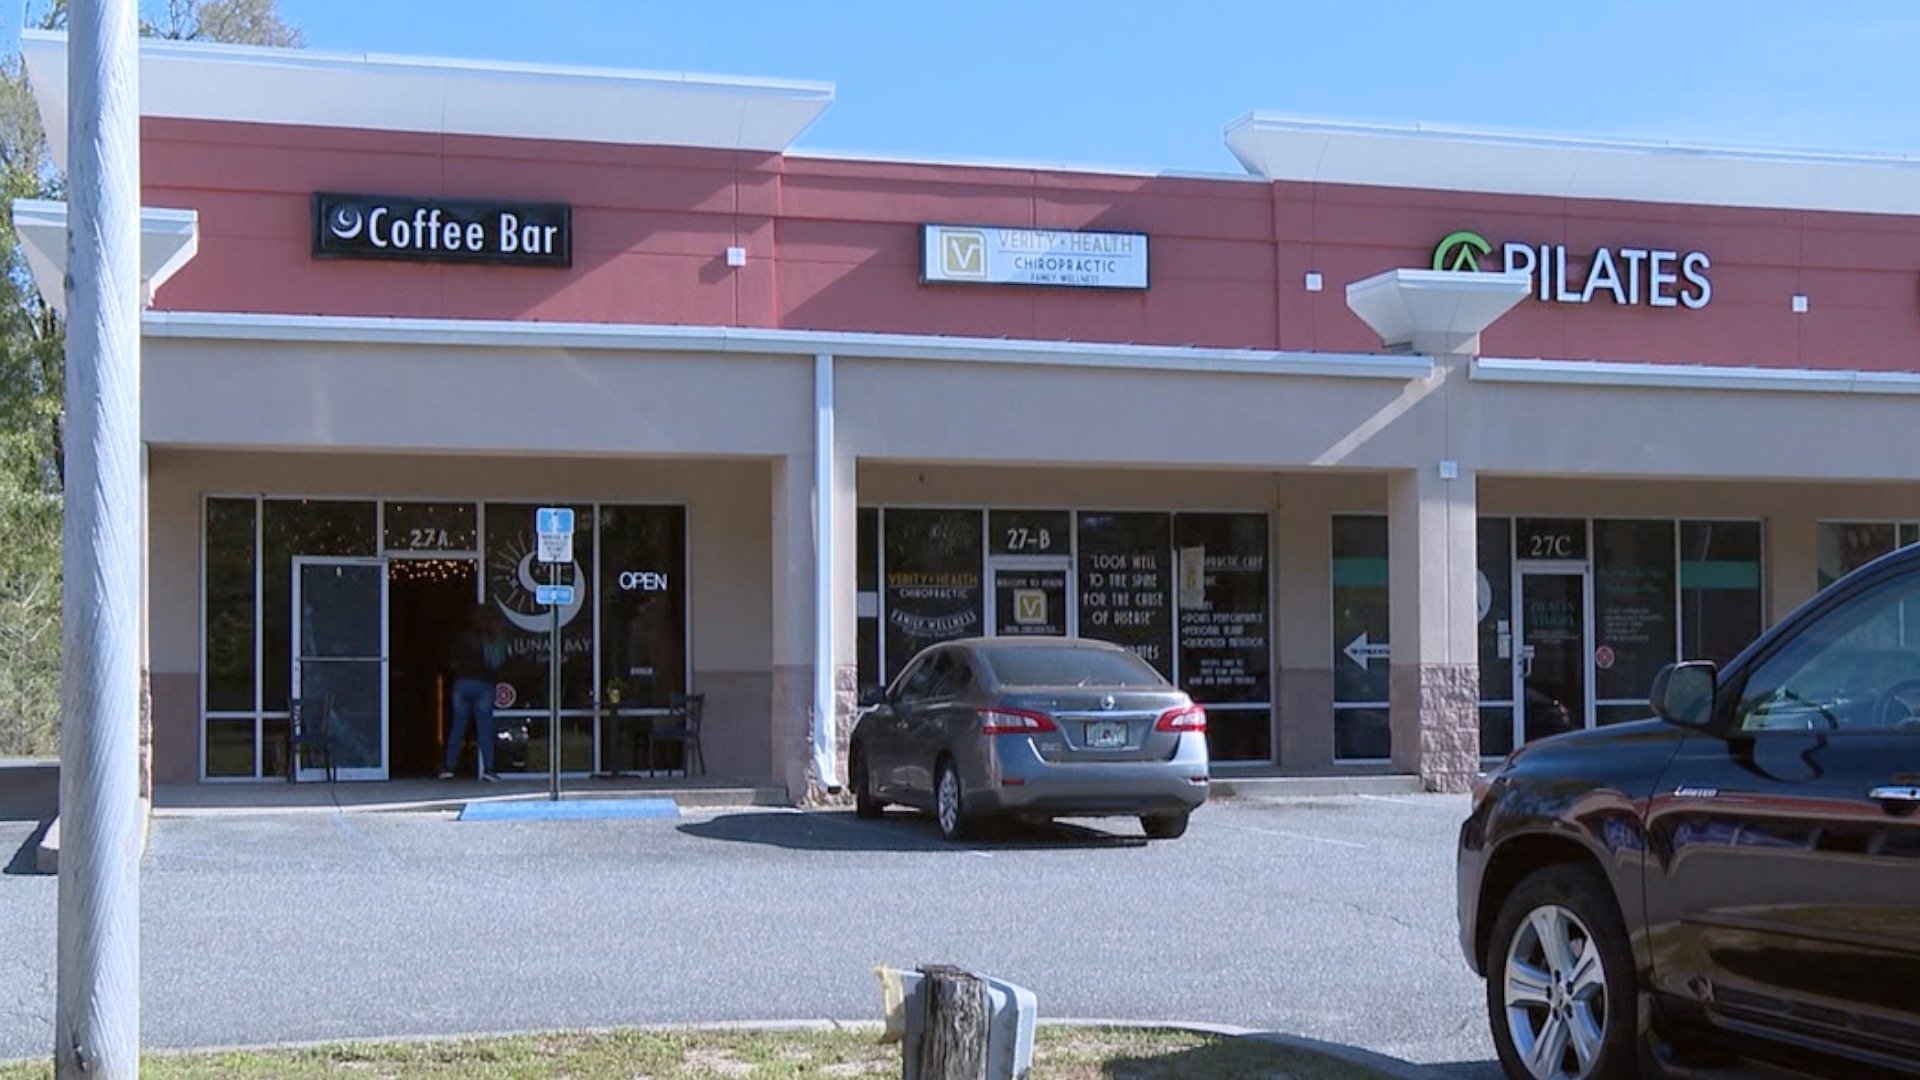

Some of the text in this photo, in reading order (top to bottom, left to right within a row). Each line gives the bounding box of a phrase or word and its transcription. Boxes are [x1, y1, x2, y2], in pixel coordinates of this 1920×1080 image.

[368, 207, 558, 253] Coffee Bar
[998, 230, 1132, 253] VERITY HEALTH
[1014, 257, 1116, 273] CHIROPRACTIC
[1030, 273, 1100, 283] FAMILY WELLNESS
[1503, 242, 1711, 309] PILATES
[410, 528, 449, 548] 27A
[1007, 528, 1050, 550] 27-B
[1530, 535, 1572, 556] 27C
[1132, 554, 1156, 570] WELL
[618, 571, 668, 591] OPEN
[887, 573, 977, 586] VERITY HEALTH
[1089, 573, 1104, 587] TO
[1109, 573, 1127, 588] THE
[899, 588, 969, 599] CHIROPRACTIC
[1082, 592, 1106, 606] FOR
[1112, 592, 1130, 606] THE
[890, 607, 977, 631] FAMILY WELLNESS
[1092, 610, 1108, 625] OF
[513, 638, 592, 653] LUNA BAY
